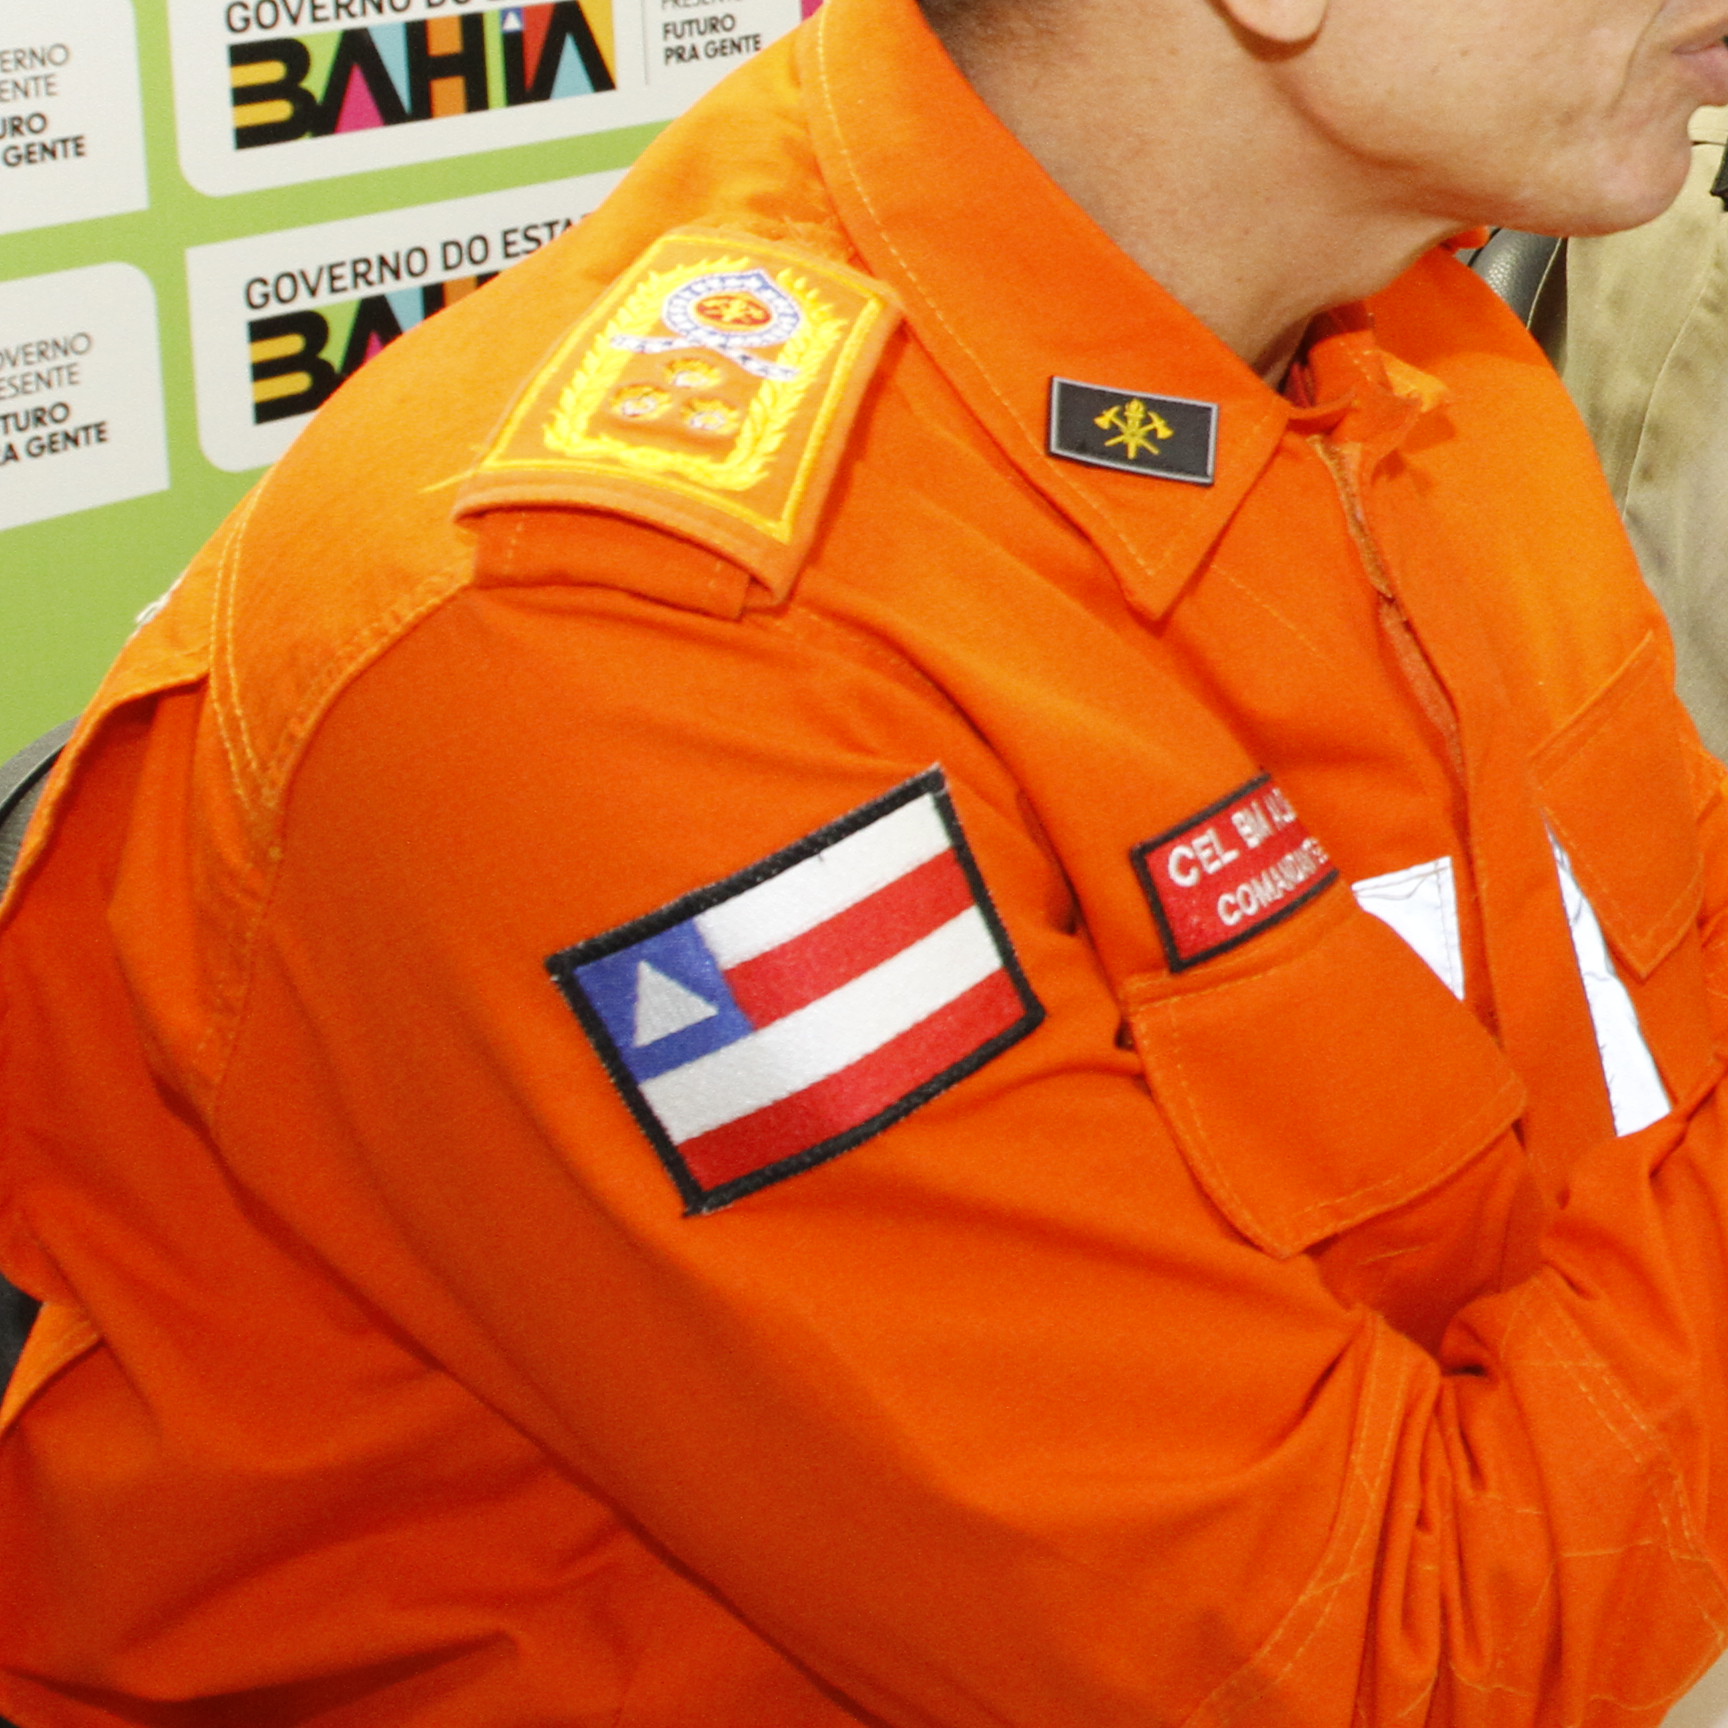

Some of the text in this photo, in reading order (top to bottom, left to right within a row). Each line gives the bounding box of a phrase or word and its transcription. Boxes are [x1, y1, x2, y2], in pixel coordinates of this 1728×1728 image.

[663, 15, 737, 43] FUTURO
[0, 42, 70, 71] ERNO
[664, 32, 763, 66] PRA GENTE
[0, 73, 58, 102] ENTE
[3, 135, 86, 167] GENTE
[244, 246, 429, 312] GOVERNO
[442, 234, 489, 271] DO
[0, 331, 92, 370] OVERNO
[0, 363, 80, 401] ESENTE
[0, 401, 71, 435] TURO
[25, 421, 109, 458] GENTE
[1168, 827, 1240, 887] CEL
